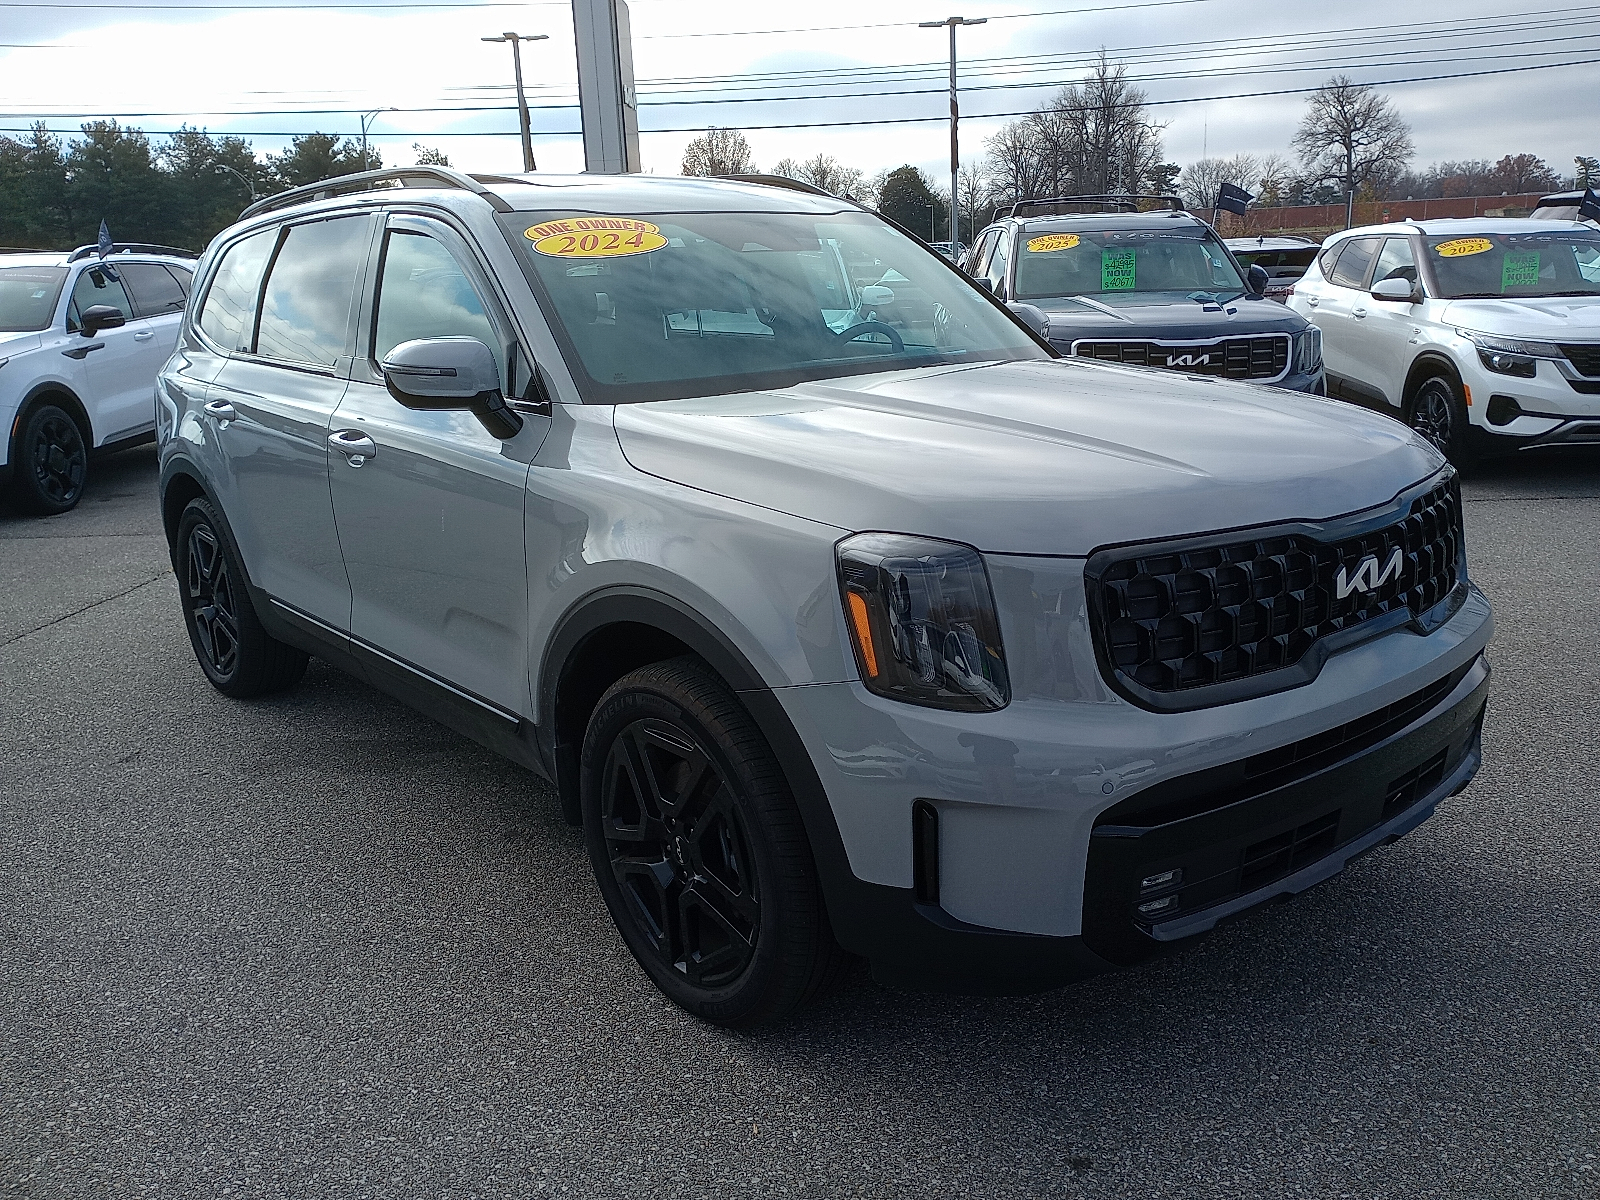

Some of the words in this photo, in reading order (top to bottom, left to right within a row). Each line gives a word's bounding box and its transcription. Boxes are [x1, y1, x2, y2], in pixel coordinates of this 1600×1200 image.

[533, 222, 573, 237] ONE
[575, 219, 646, 232] OWNER
[556, 232, 644, 254] 2024
[1031, 237, 1045, 245] ONE
[1036, 241, 1069, 251] 2025
[1450, 243, 1483, 255] 2023
[1108, 252, 1132, 260] WAS
[1107, 269, 1132, 277] NOW
[1507, 272, 1535, 280] NOW
[1166, 353, 1210, 367] KIA
[1334, 545, 1403, 600] KIA
